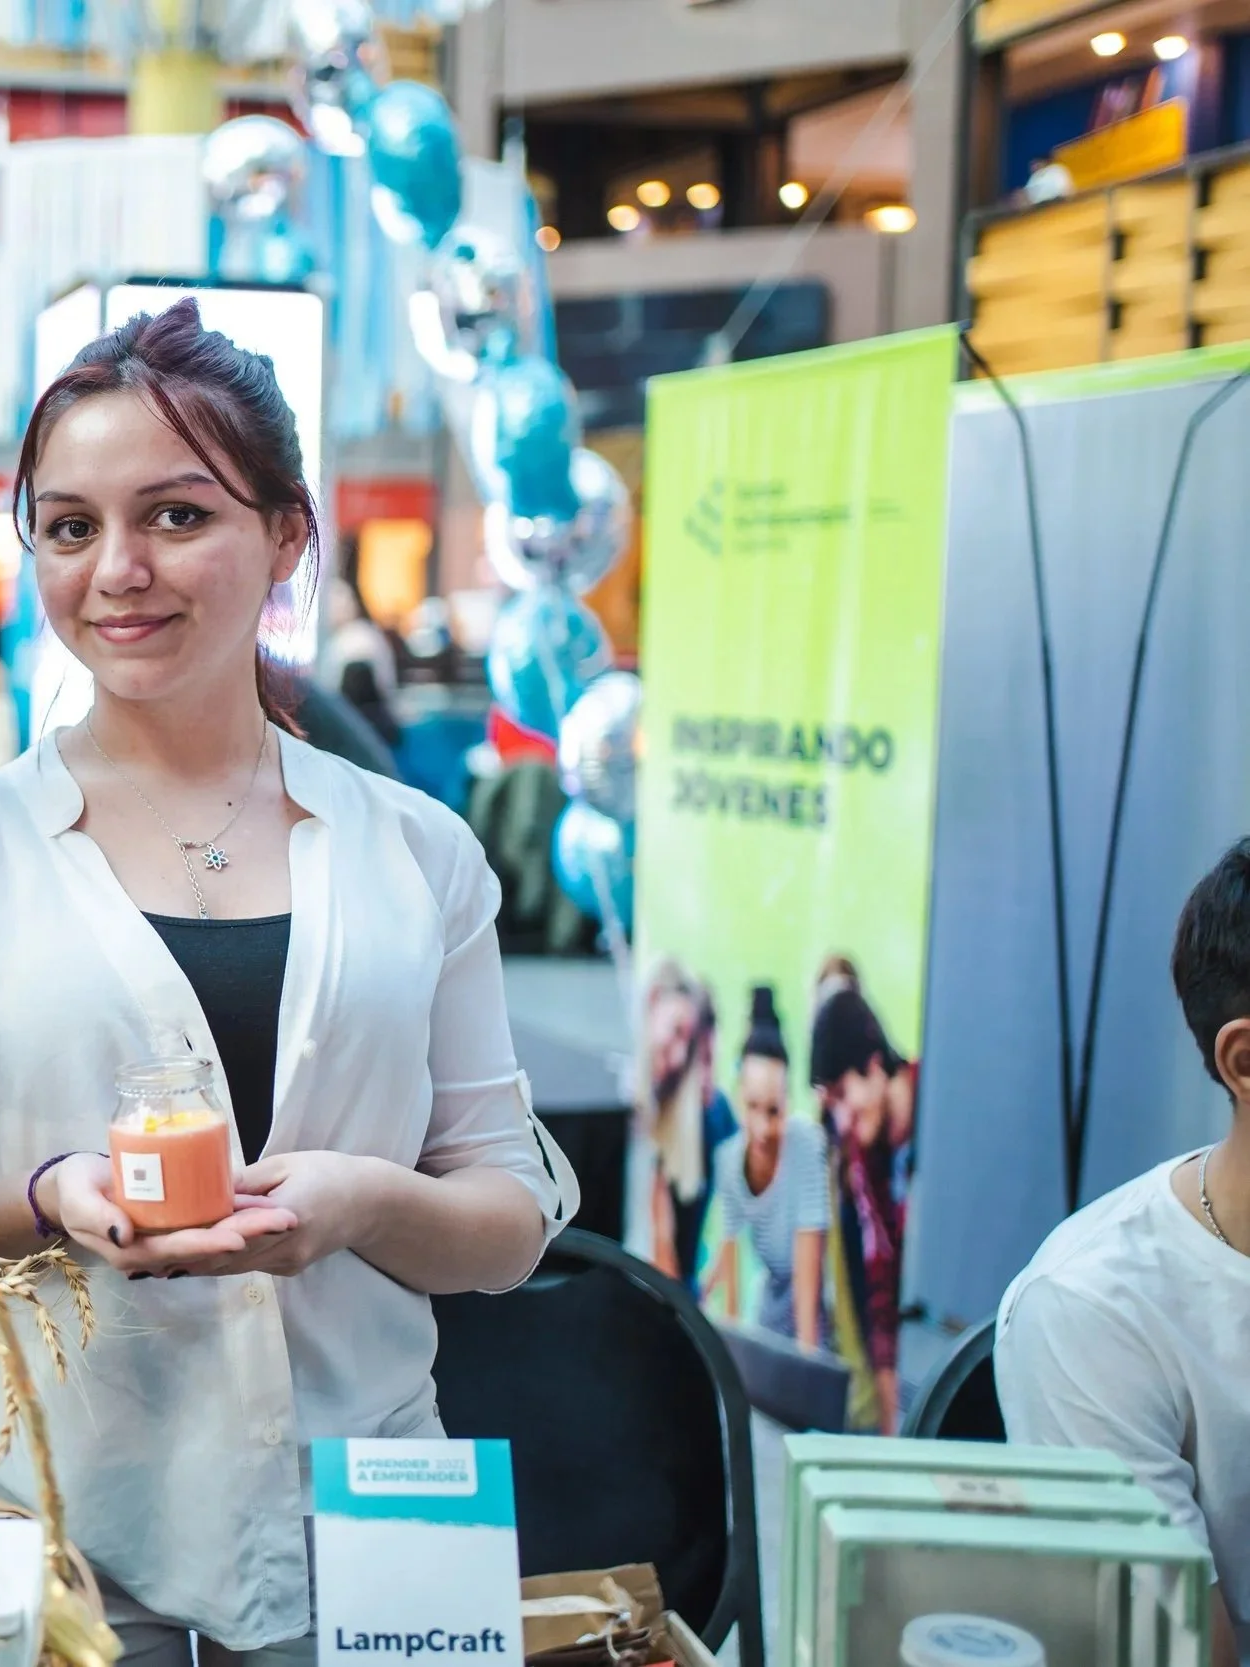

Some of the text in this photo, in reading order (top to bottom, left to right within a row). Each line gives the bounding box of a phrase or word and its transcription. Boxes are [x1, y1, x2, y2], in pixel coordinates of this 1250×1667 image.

[673, 716, 894, 773] INSPIRANDO
[356, 1458, 429, 1469] APRENDER
[357, 1471, 469, 1483] A EMPRENDER
[336, 1627, 506, 1657] LampCraft
